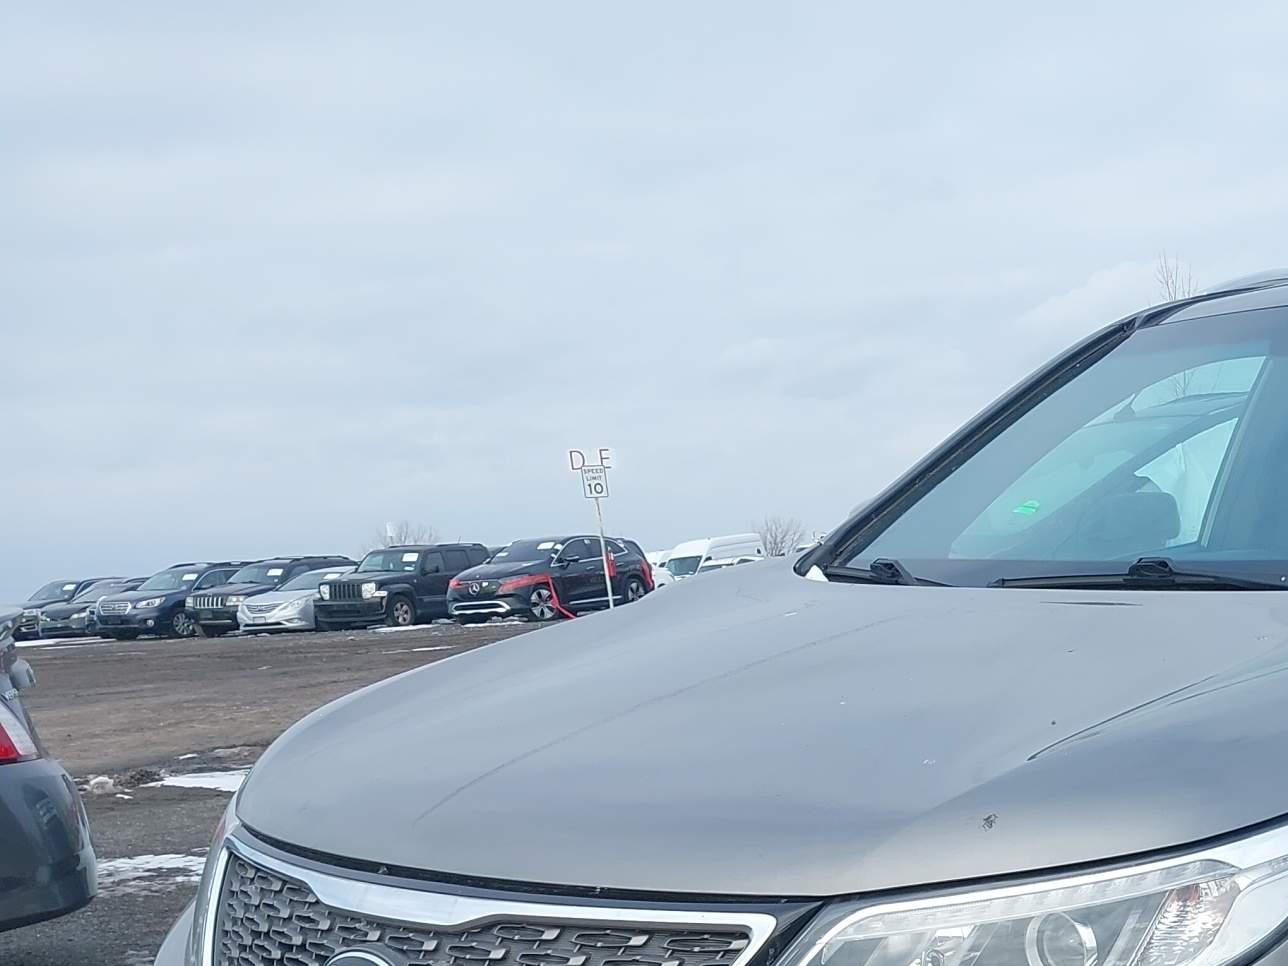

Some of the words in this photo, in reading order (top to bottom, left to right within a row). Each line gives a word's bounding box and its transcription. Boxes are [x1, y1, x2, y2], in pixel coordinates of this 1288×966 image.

[569, 450, 586, 470] D
[599, 448, 612, 469] E
[587, 482, 604, 495] 10
